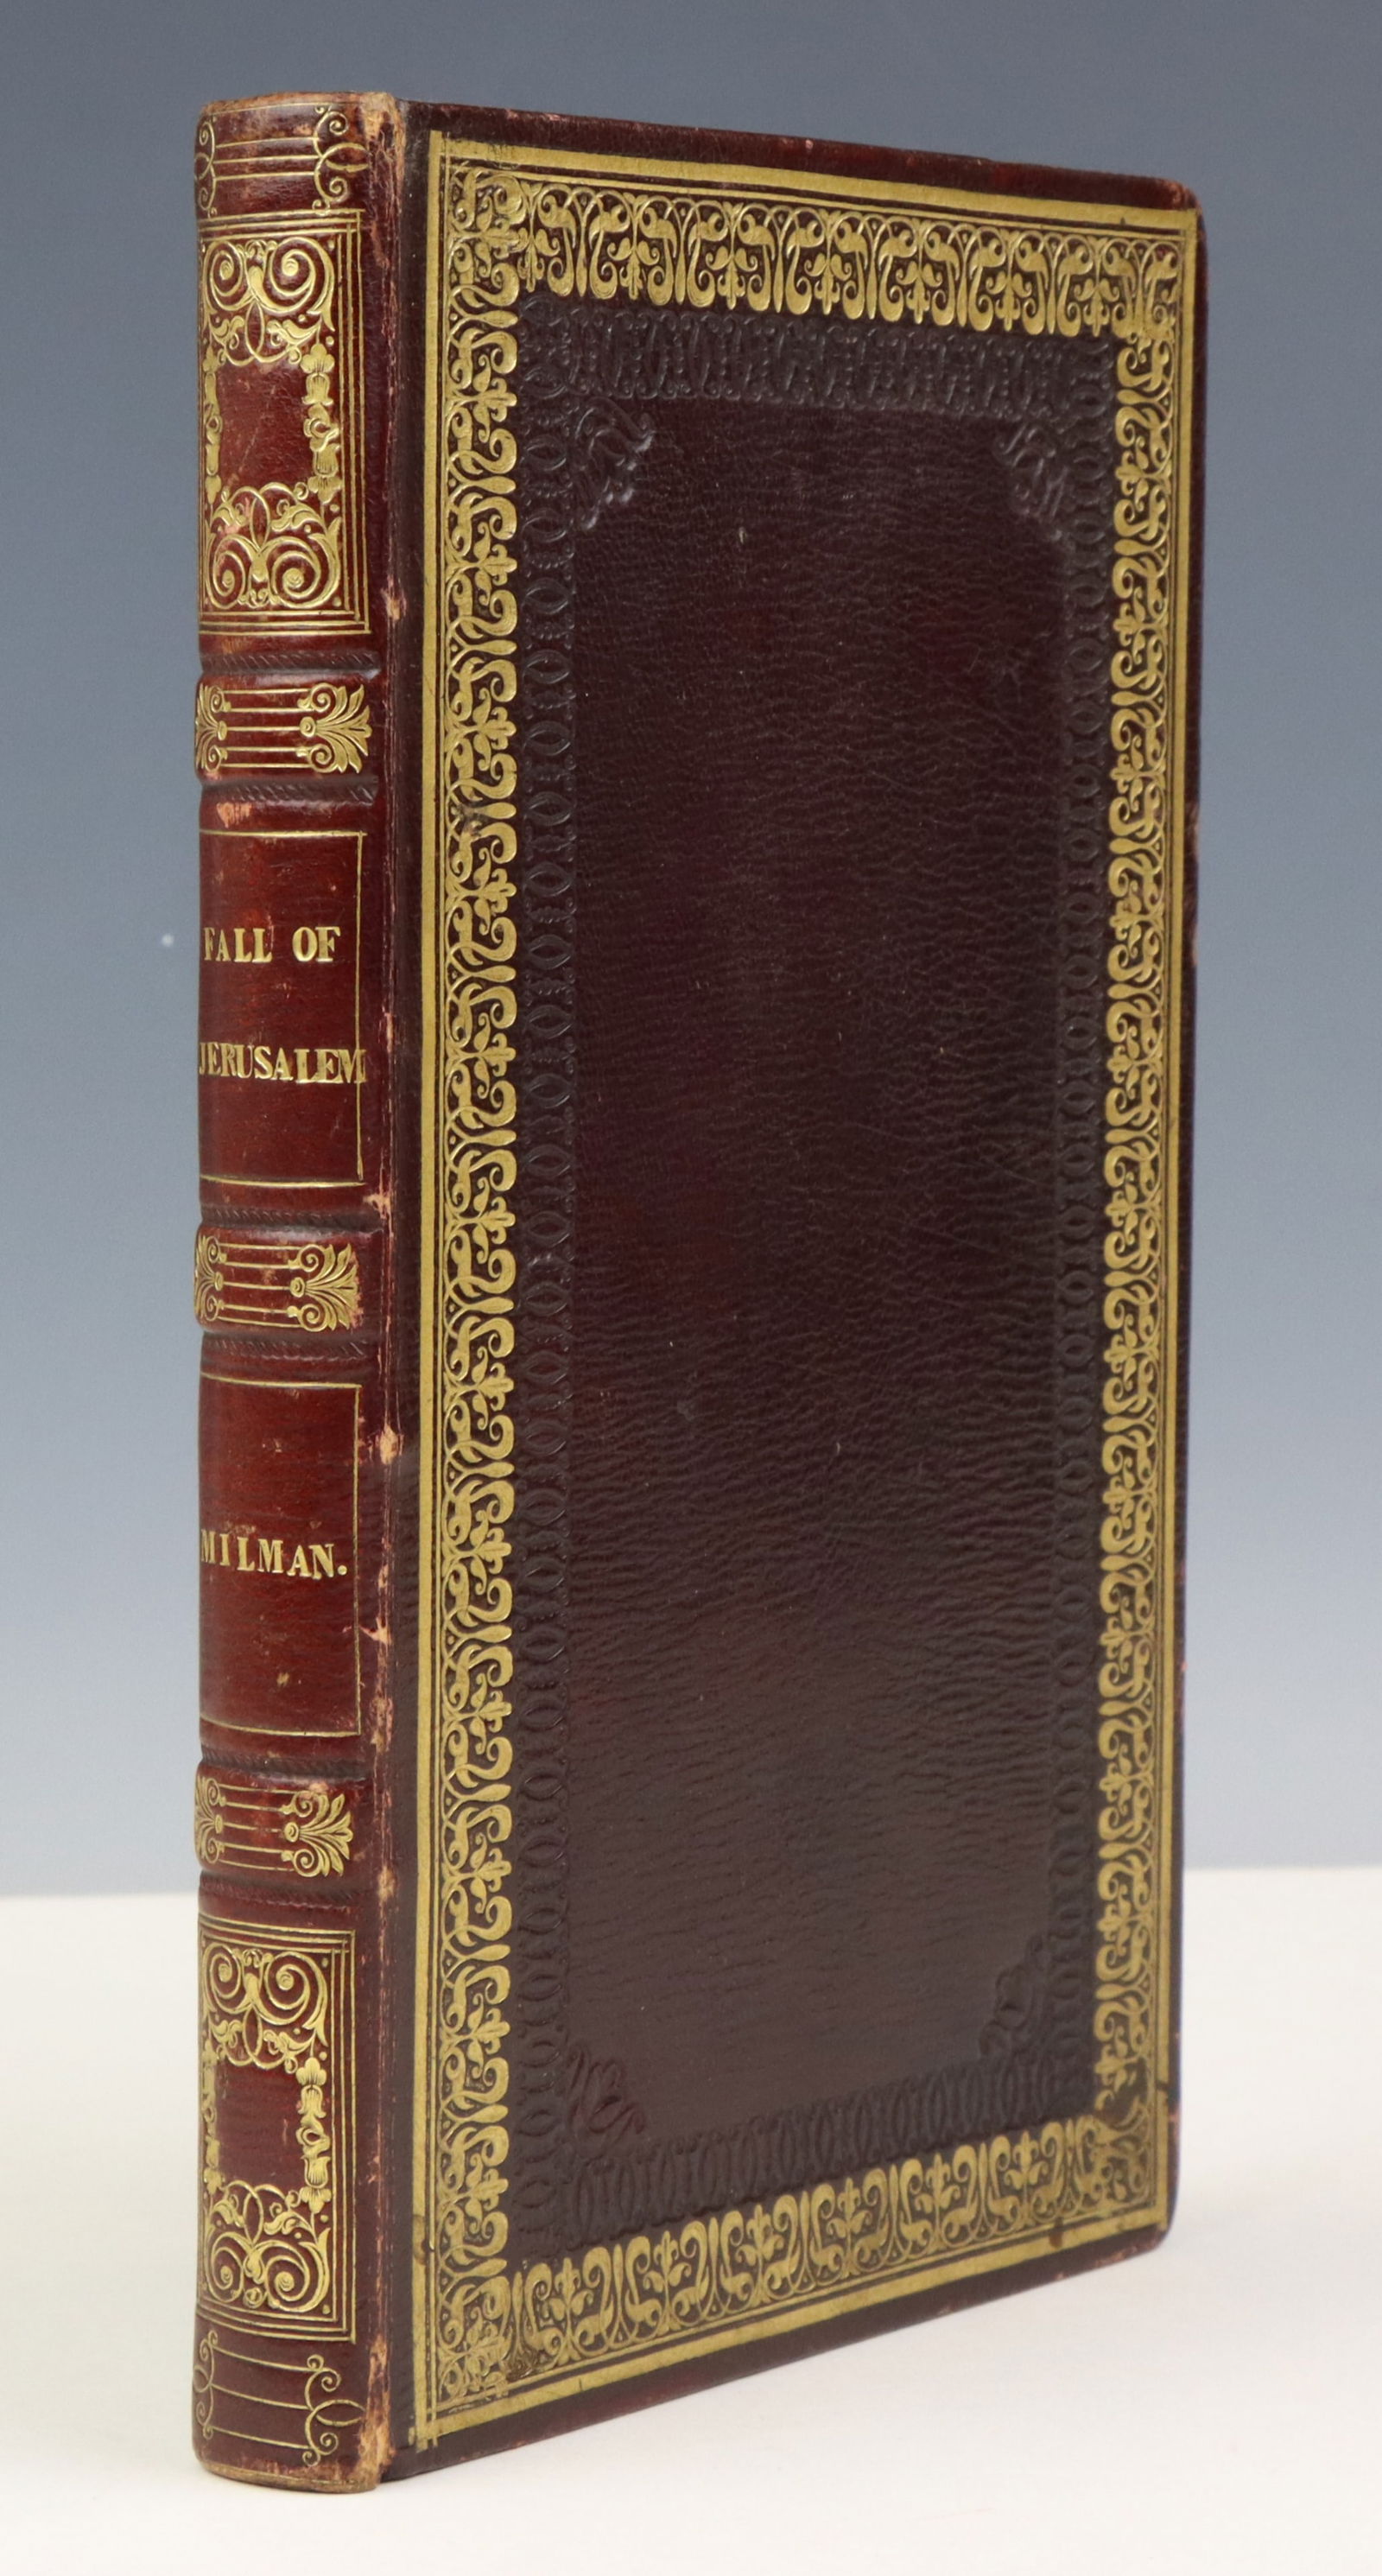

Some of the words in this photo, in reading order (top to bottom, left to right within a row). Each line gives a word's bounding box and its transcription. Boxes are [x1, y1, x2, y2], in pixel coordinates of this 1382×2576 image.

[203, 926, 273, 963] FALL
[292, 926, 341, 962] OF
[199, 1042, 367, 1084] JERUSALEM
[201, 1528, 348, 1580] MILMAN.
